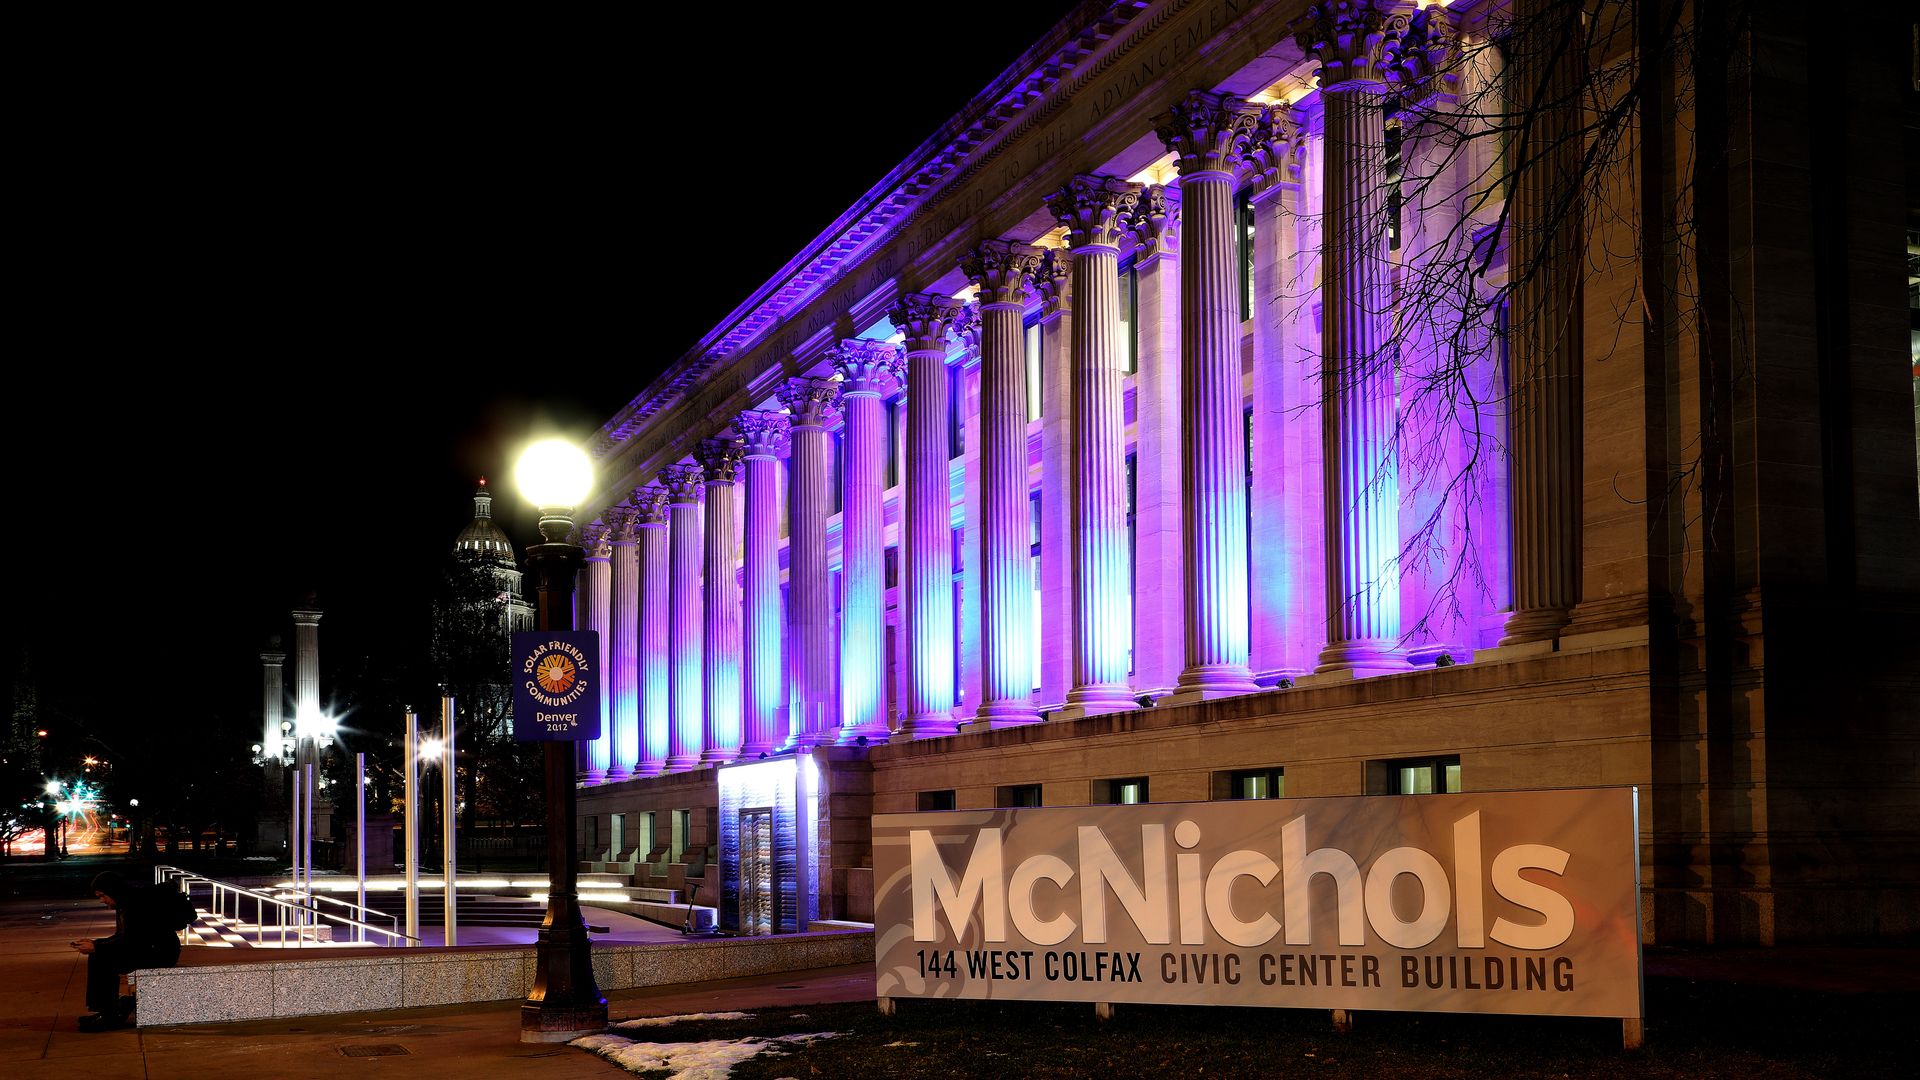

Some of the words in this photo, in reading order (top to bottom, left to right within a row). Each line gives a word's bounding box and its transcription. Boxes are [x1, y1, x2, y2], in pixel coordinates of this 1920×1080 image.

[832, 285, 857, 313] NINE
[870, 259, 892, 285] AND
[908, 189, 984, 256] DEDICATED
[1034, 124, 1066, 160] THE
[1090, 0, 1253, 121] ADVANCEMEN
[523, 644, 548, 674] SOLAR
[548, 640, 590, 672] FRIENDLY
[525, 679, 588, 707] COMMUNITIES
[536, 711, 578, 722] Denver
[546, 723, 568, 732] 2012
[908, 810, 1575, 950] McNichols
[916, 949, 958, 981] 144
[967, 950, 1033, 982] WEST
[1044, 951, 1143, 984] COLFAX
[1160, 953, 1241, 985] CIVIC
[1259, 953, 1381, 989] CENTER
[1400, 954, 1575, 992] BUILDING
